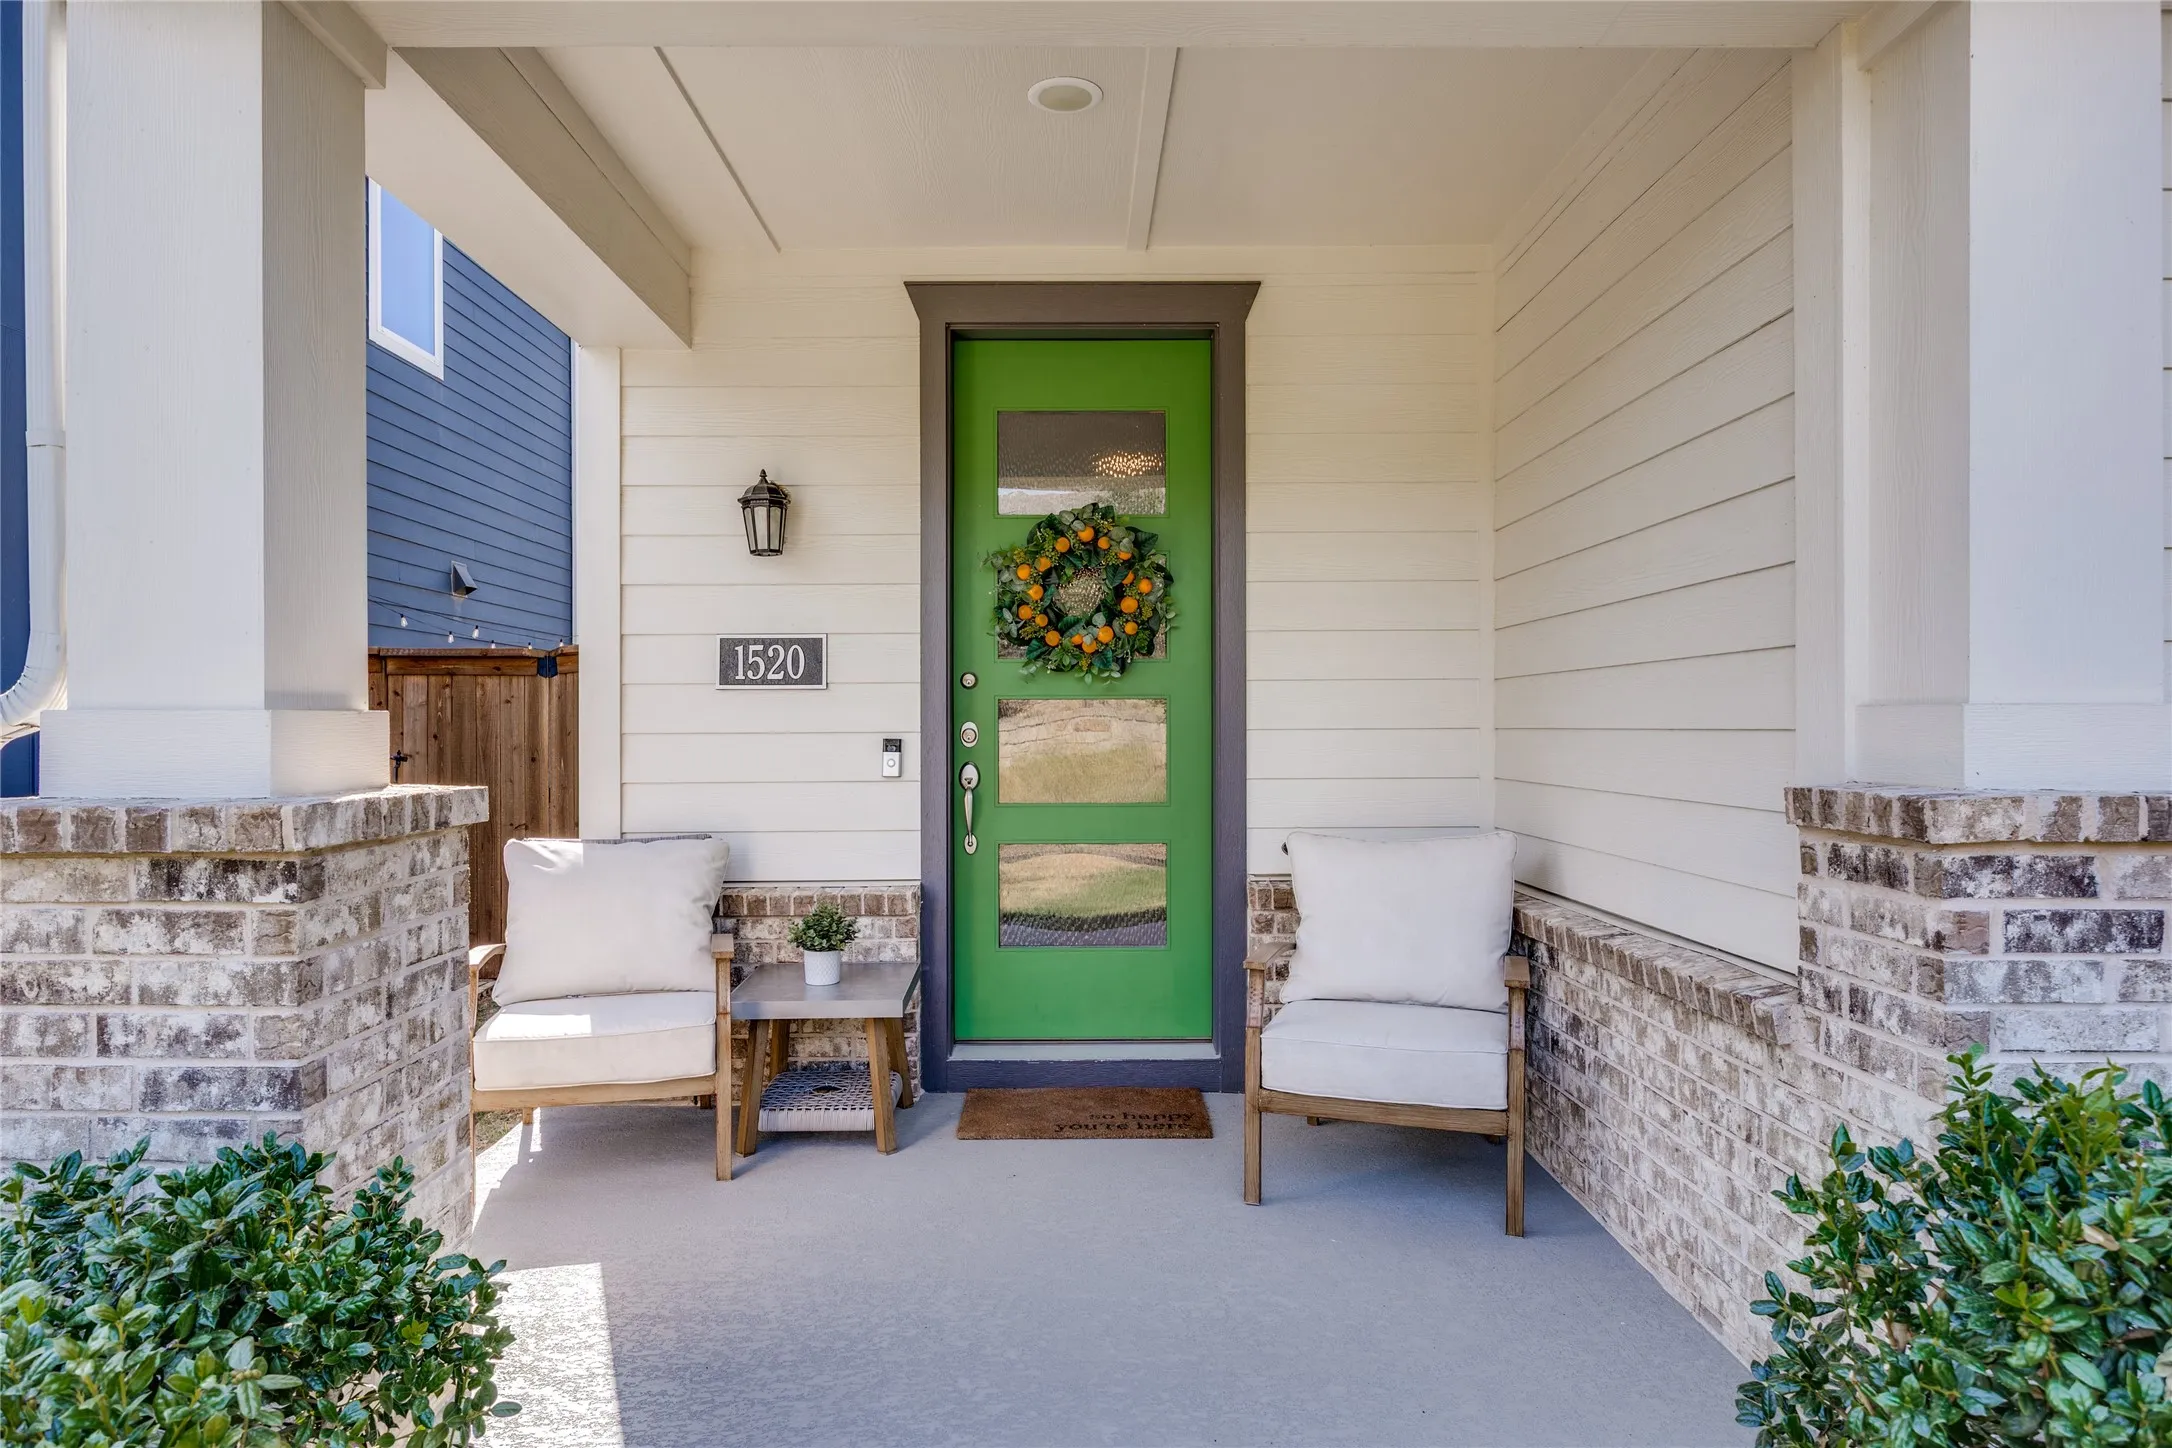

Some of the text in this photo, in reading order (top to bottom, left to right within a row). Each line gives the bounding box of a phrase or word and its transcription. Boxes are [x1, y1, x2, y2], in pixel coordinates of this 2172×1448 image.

[734, 644, 805, 680] 1520
[1122, 1112, 1195, 1122] happy
[1054, 1122, 1129, 1132] you're
